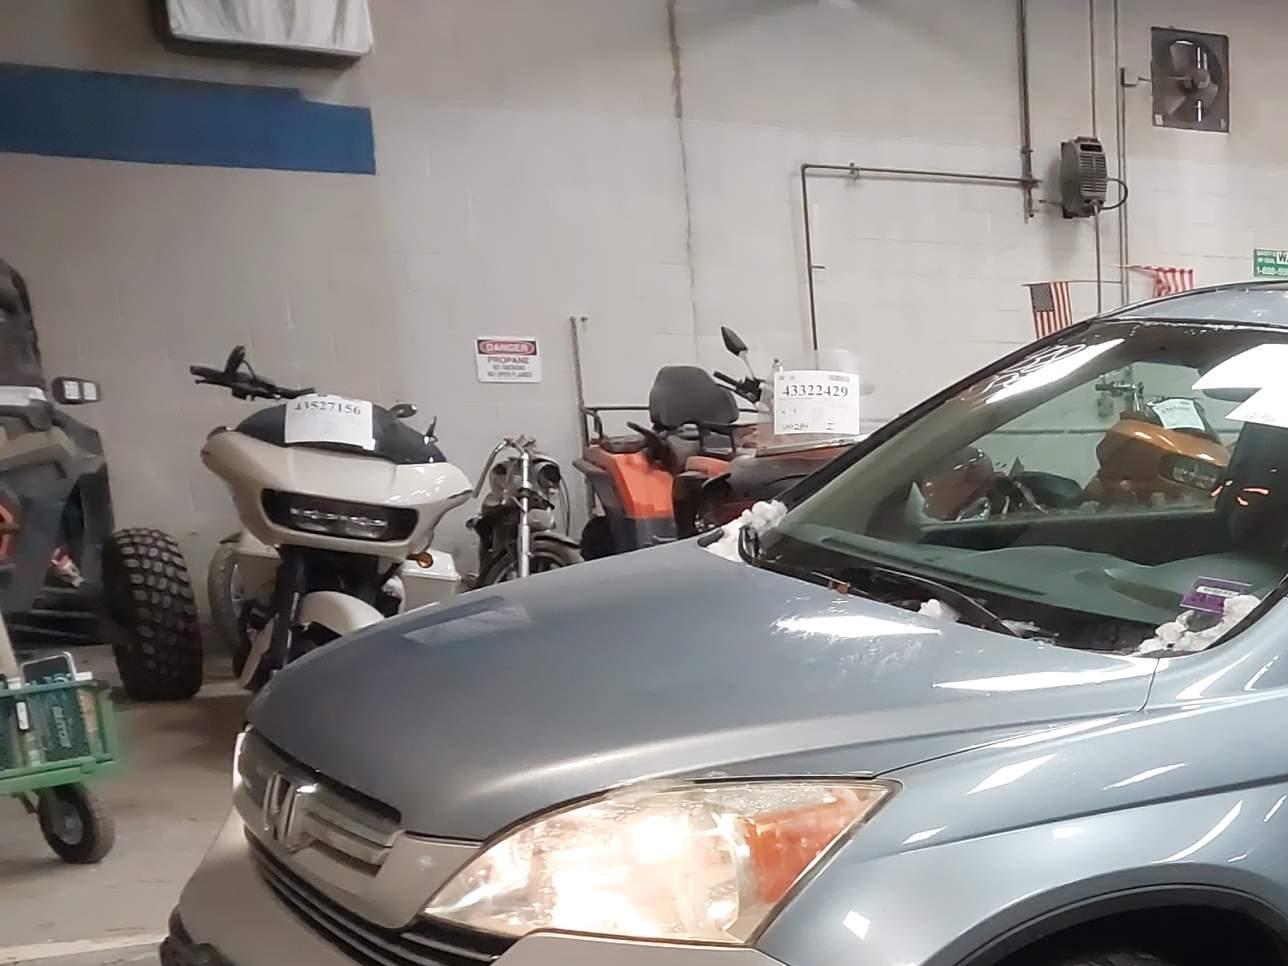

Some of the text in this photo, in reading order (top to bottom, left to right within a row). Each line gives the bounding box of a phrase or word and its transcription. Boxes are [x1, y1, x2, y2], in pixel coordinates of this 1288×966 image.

[486, 343, 529, 352] DANGER
[487, 356, 529, 364] PROPANE
[782, 384, 849, 397] 43322429
[294, 400, 362, 415] 43527156
